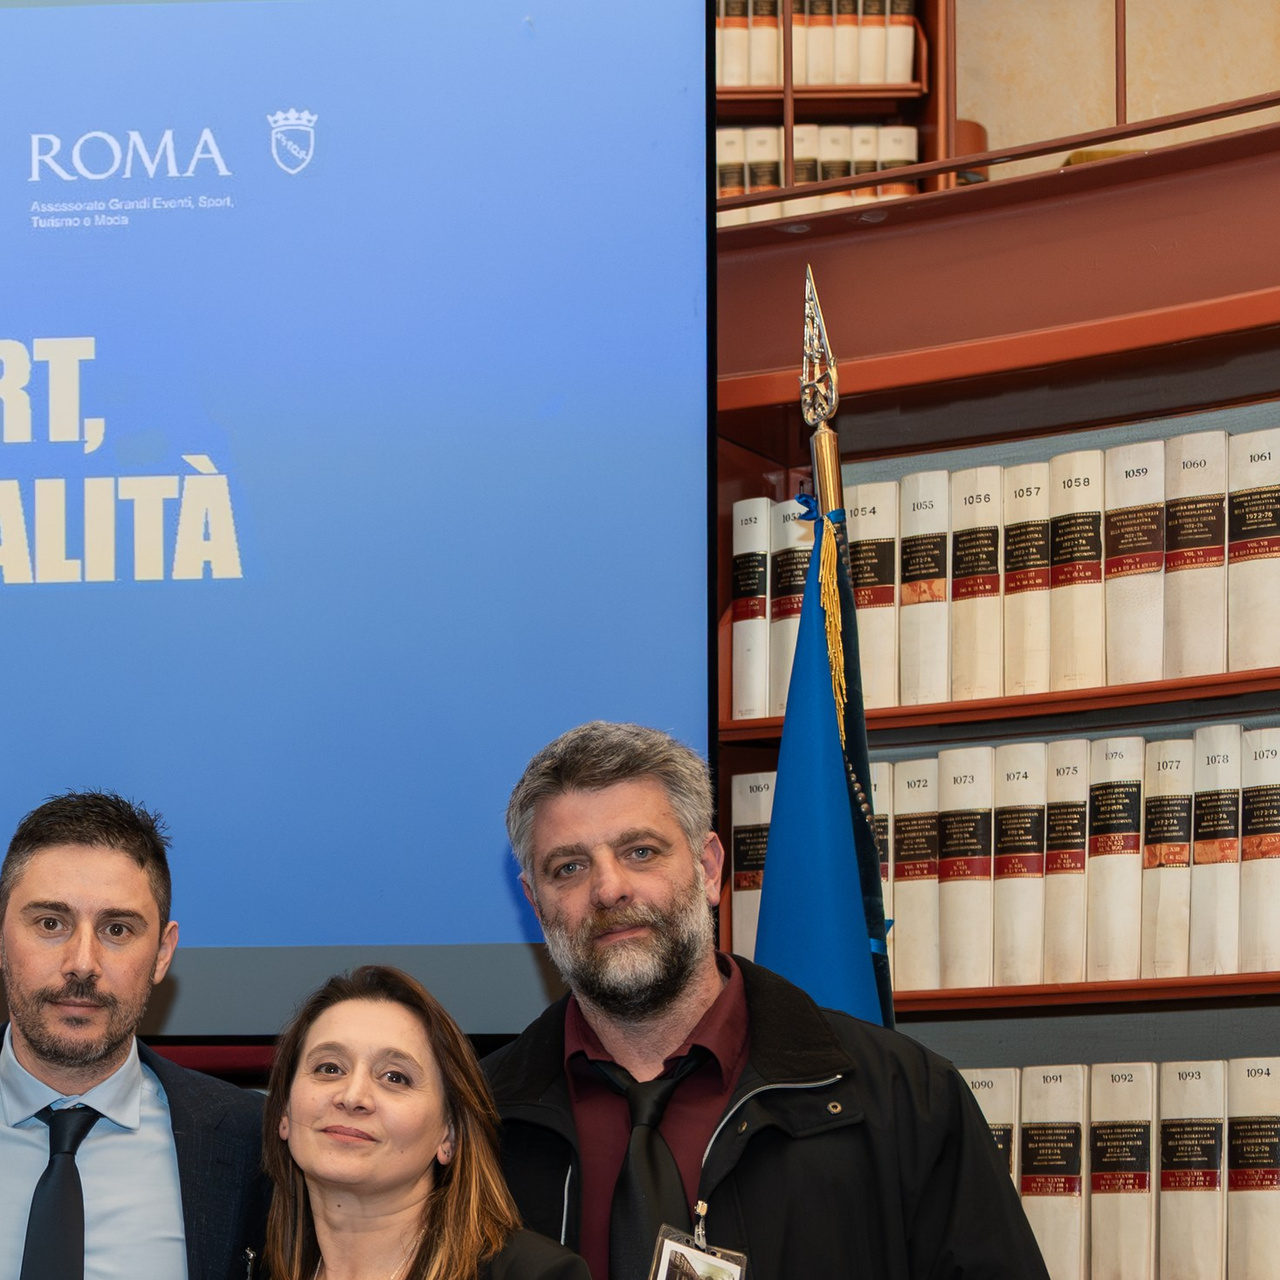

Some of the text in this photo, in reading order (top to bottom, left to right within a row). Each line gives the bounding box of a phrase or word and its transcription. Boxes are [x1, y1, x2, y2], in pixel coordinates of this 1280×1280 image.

[29, 128, 231, 181] ROMA
[108, 197, 150, 211] Grandi
[1250, 452, 1270, 462] 1061
[1183, 460, 1206, 469] 1060
[1125, 468, 1147, 478] 1059
[1063, 478, 1089, 489] 1058
[1014, 487, 1040, 498] 1057
[964, 494, 990, 505] 1056
[913, 501, 933, 511] 1055
[850, 507, 876, 518] 1054
[741, 517, 757, 526] 1052
[1105, 750, 1123, 760] 1076
[1207, 755, 1228, 765] 1078
[1254, 750, 1277, 760] 1079
[1157, 761, 1180, 771] 1077
[1007, 772, 1028, 781] 1074
[1056, 767, 1077, 776] 1075
[907, 779, 927, 788] 1072
[954, 776, 974, 784] 1073
[749, 784, 769, 793] 1069
[1178, 1071, 1201, 1080] 1093
[1247, 1068, 1270, 1077] 1094
[1043, 1075, 1062, 1083] 1091
[1111, 1074, 1133, 1083] 1092
[971, 1080, 994, 1090] 1090
